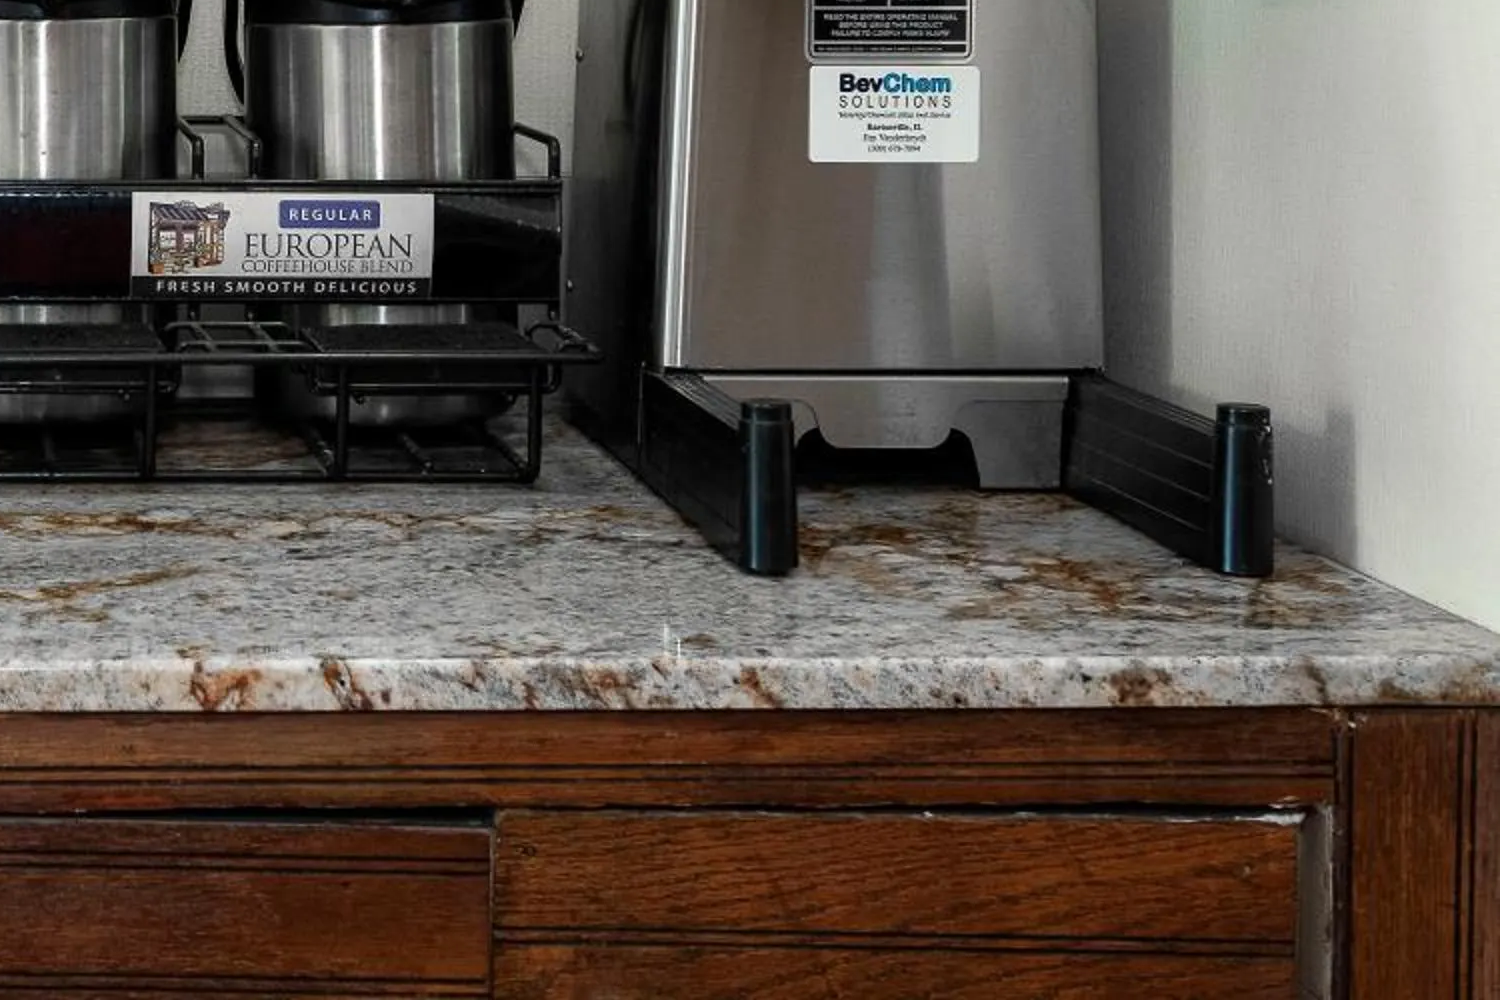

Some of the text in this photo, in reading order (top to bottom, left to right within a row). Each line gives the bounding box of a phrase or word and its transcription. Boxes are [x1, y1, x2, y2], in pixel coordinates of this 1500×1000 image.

[839, 72, 951, 92] BevChem
[839, 95, 952, 108] SOLUTIONS
[288, 207, 373, 222] REGULAR
[244, 233, 412, 259] EUROPEAN
[241, 259, 414, 274] COFFEEHOUSE BLEND
[155, 280, 417, 294] FRESH SMOOTH DELICIOUS
